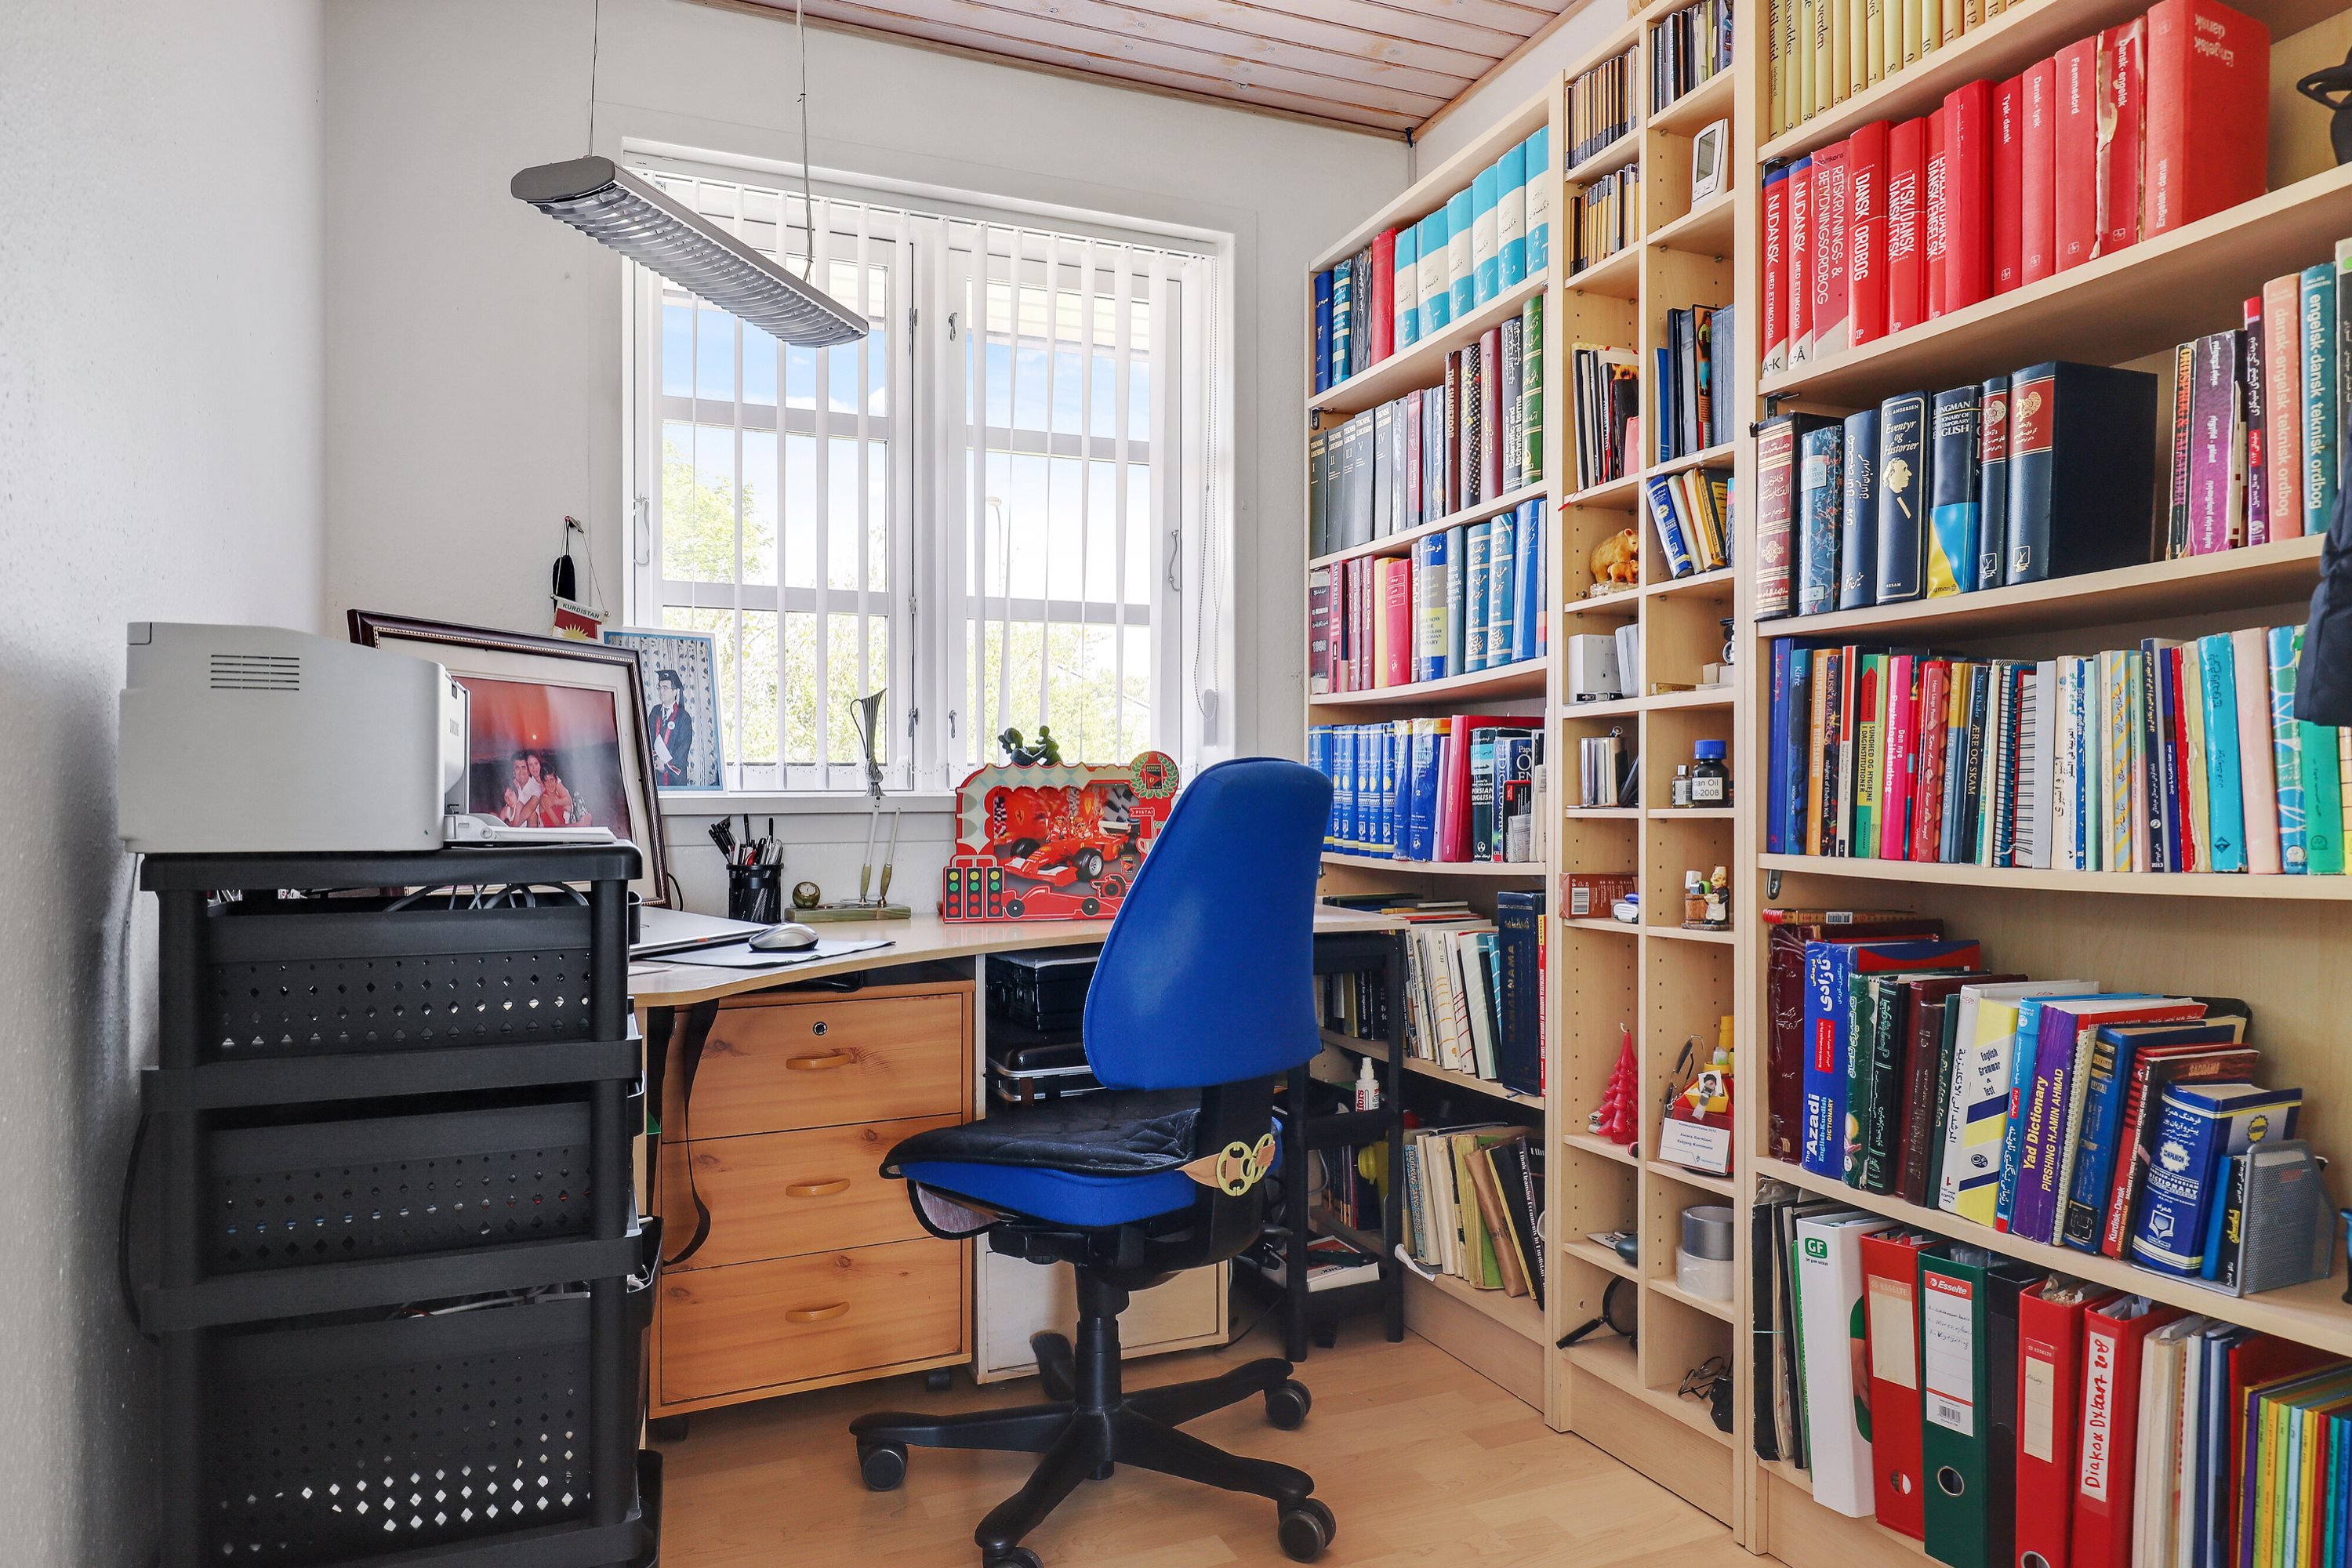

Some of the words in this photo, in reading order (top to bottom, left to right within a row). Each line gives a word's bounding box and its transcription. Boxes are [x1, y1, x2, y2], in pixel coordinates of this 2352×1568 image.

[1966, 12, 1976, 27] 12
[1988, 2, 1998, 18] 13
[1817, 4, 1828, 50] verden
[1945, 28, 1954, 42] 11
[1923, 38, 1932, 53] 10
[1886, 64, 1896, 73] 8
[1905, 53, 1915, 62] 9
[1853, 84, 1861, 93] 6
[2070, 57, 2080, 115] Fremmedord
[1786, 123, 1794, 132] 2
[1854, 172, 1871, 222] DANSK
[1793, 181, 1806, 257] NUDANSK
[1831, 165, 1844, 265] RETSKRIVNINGS-
[1899, 173, 1915, 257] TYSK/DANSK
[1927, 159, 1939, 261] DANSK/ENGELSK
[1767, 194, 1780, 267] NUDANSK
[1889, 180, 1900, 263] DANSK/TYSK
[1817, 170, 1830, 305] BETYDNINGSORDBOG
[1853, 226, 1870, 282] ORDBOG
[1831, 267, 1843, 278] &
[1856, 329, 1864, 339] P
[1893, 321, 1901, 332] P
[2307, 293, 2325, 399] engelsk-dansk
[1762, 357, 1780, 374] A-K
[2274, 307, 2289, 408] dansk-engelsk
[2176, 347, 2191, 417] ORDSPROG
[1893, 404, 1919, 414] ANDERSEN
[1885, 419, 1917, 435] Eventyr
[2177, 418, 2189, 428] &
[2310, 401, 2325, 456] teknisk
[1358, 441, 1363, 451] V
[1378, 432, 1386, 444] IV
[1508, 426, 1516, 469] Scientific
[1514, 424, 1523, 466] technical
[1883, 440, 1919, 457] Historier
[1894, 433, 1904, 443] og
[2276, 412, 2291, 463] teknisk
[1330, 455, 1335, 465] II
[2275, 465, 2292, 517] ordbog
[2309, 459, 2325, 511] ordbog
[562, 601, 601, 620] KURDISTAN
[1793, 666, 1802, 688] Kirre
[1884, 694, 1898, 793] Psykologihåndbog
[1970, 724, 1980, 746] ÆRE
[1859, 730, 1867, 793] DAGINSTITUTIONER
[1896, 746, 1905, 758] nye
[1969, 748, 1979, 764] OG
[1867, 759, 1875, 769] OG
[1944, 757, 1954, 770] jeg!
[1967, 768, 1977, 795] SKAM
[1815, 958, 1834, 1012] ئازادی
[1980, 1047, 1999, 1062] English
[1978, 1061, 2002, 1076] Grammar
[1984, 1085, 1996, 1096] Test
[2140, 1084, 2149, 1101] OMEGN
[2026, 1074, 2050, 1142] Dictionary
[2136, 1108, 2145, 1126] KERKUK
[1806, 1094, 1820, 1156] Azadi
[1818, 1097, 1828, 1162] English-Kurdish
[1826, 1098, 1835, 1142] DICTIONARY
[2042, 1143, 2056, 1192] PIRSHING
[2053, 1068, 2063, 1103] AHMAD
[2129, 1128, 2144, 1161] UDRENSNINGER
[1519, 1151, 1528, 1171] Ethnic
[2022, 1142, 2037, 1170] Yad
[2128, 1161, 2137, 1179] ETNISKE
[1523, 1171, 1533, 1201] Cleansing
[2124, 1179, 2134, 1200] SADDAMS
[2148, 1173, 2198, 1196] DICTIONARY
[1528, 1202, 1537, 1236] Documents
[2107, 1185, 2125, 1243] Kurdisk-Dansk
[1807, 1240, 1824, 1254] GF
[1535, 1244, 1545, 1277] Kurdistan
[1881, 1283, 1907, 1296] ESSELTE
[1937, 1280, 1967, 1295] Esselte
[2034, 1347, 2053, 1357] ESSELTE
